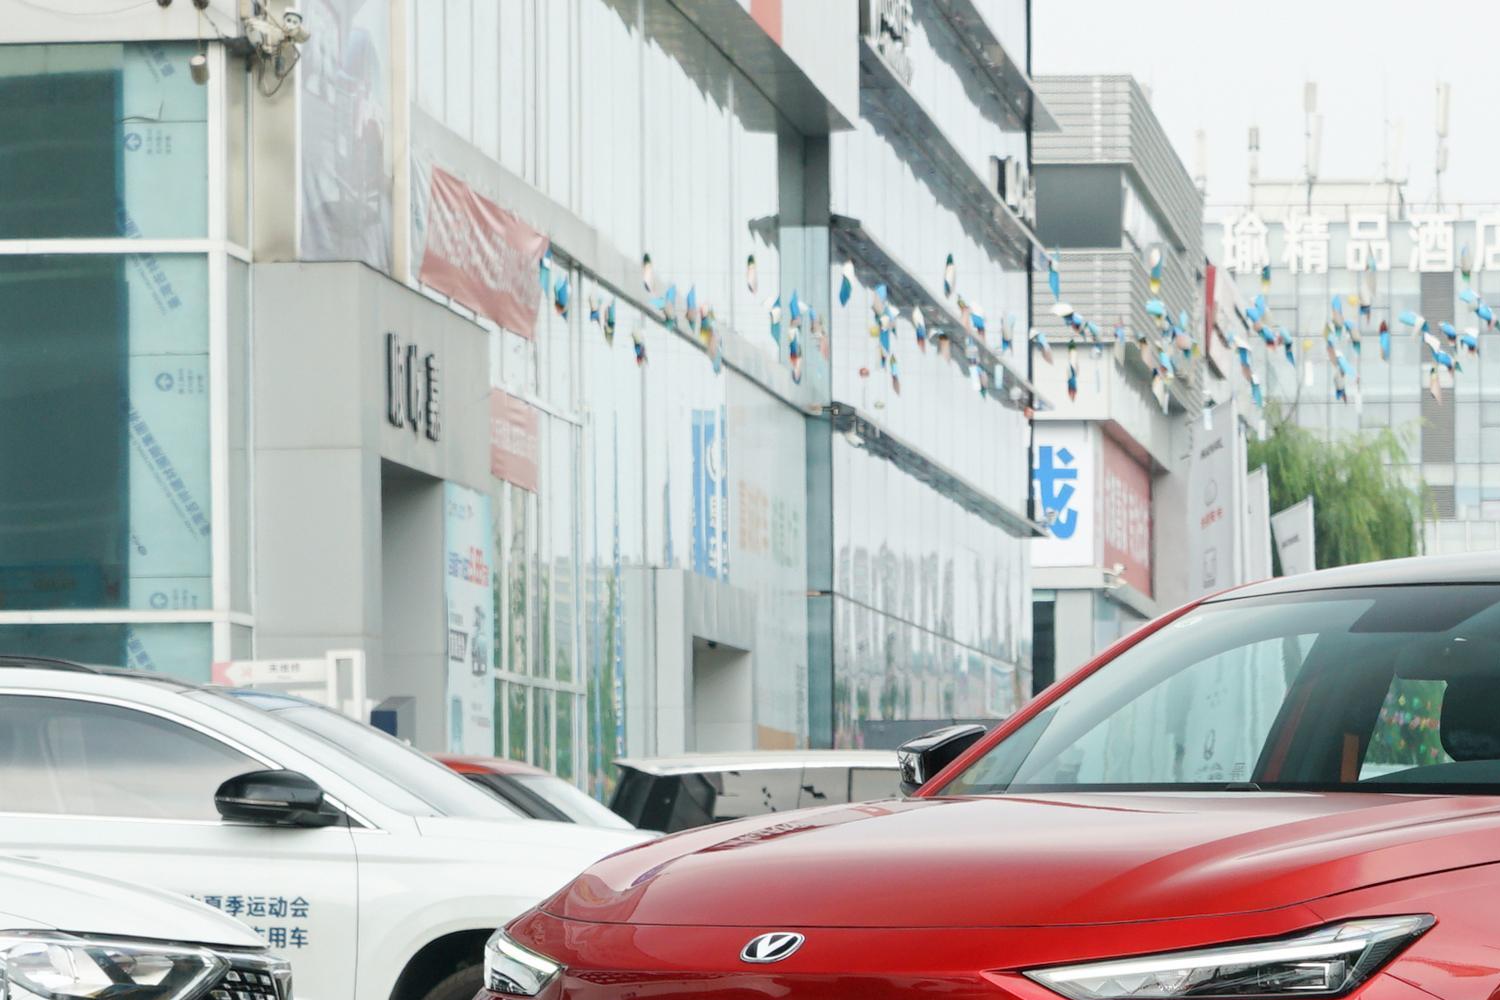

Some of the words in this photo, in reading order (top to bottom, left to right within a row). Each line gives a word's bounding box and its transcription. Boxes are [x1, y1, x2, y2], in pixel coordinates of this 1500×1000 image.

[187, 894, 310, 919] 夏季运动会
